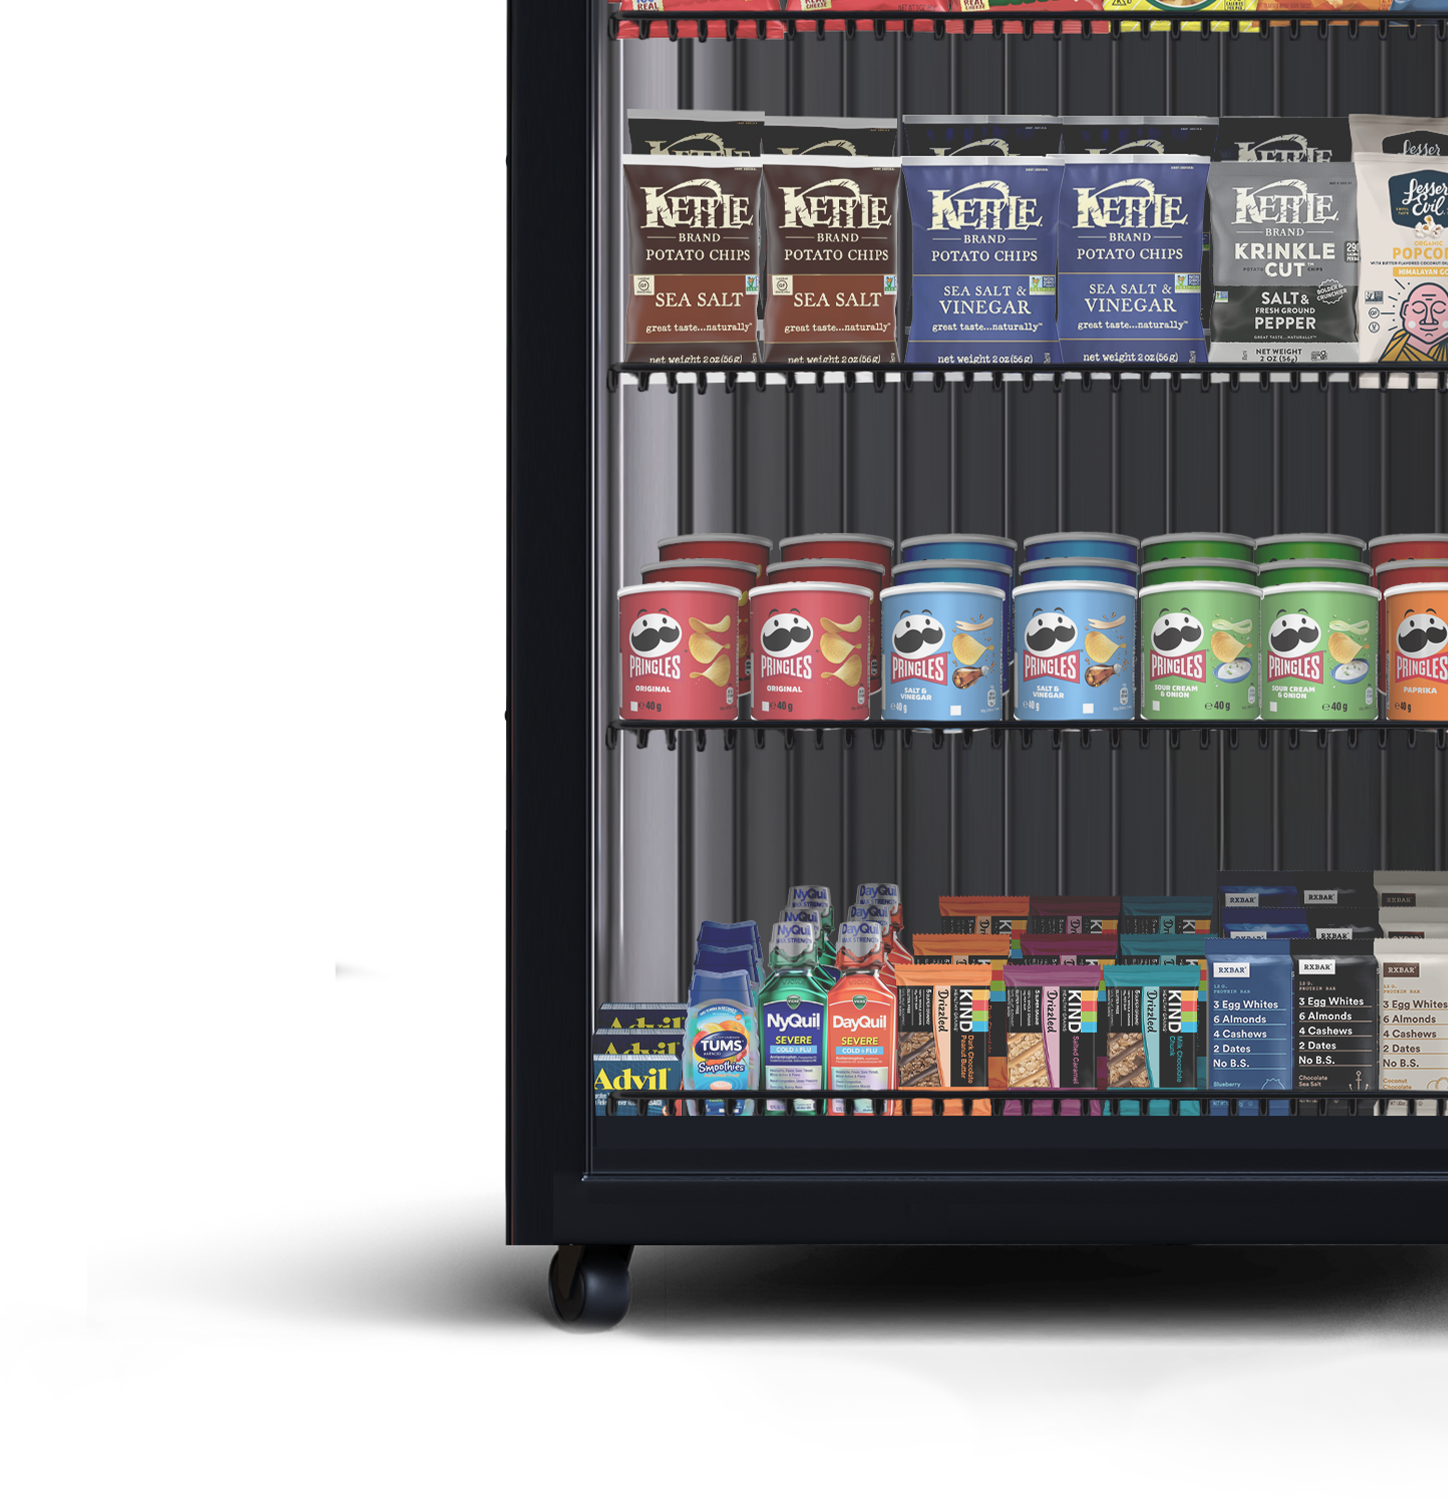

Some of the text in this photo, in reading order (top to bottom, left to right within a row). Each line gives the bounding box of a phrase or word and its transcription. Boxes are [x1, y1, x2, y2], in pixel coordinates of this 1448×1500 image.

[640, 178, 754, 229] KETTLE
[679, 233, 721, 242] BRAND
[646, 248, 751, 261] POTATO CHIPS
[655, 292, 743, 308] SEA SALT
[939, 300, 1031, 315] VINEGAR
[630, 656, 681, 679] PRINGLES
[1151, 655, 1203, 679] PRINGLES
[635, 685, 671, 693] ORIGINAL
[1219, 966, 1246, 974] RXBAR
[959, 989, 973, 1032] KIND
[1214, 1000, 1278, 1011] 3 Egg Whites
[767, 1013, 820, 1032] NyQuil
[1214, 1015, 1266, 1024] 6 Almonds
[776, 1035, 812, 1045] SEVERE
[1214, 1030, 1267, 1038] 4 Cashews
[701, 1040, 743, 1052] TUMS
[698, 1061, 745, 1073] Smoothies
[594, 1068, 667, 1091] Advil
